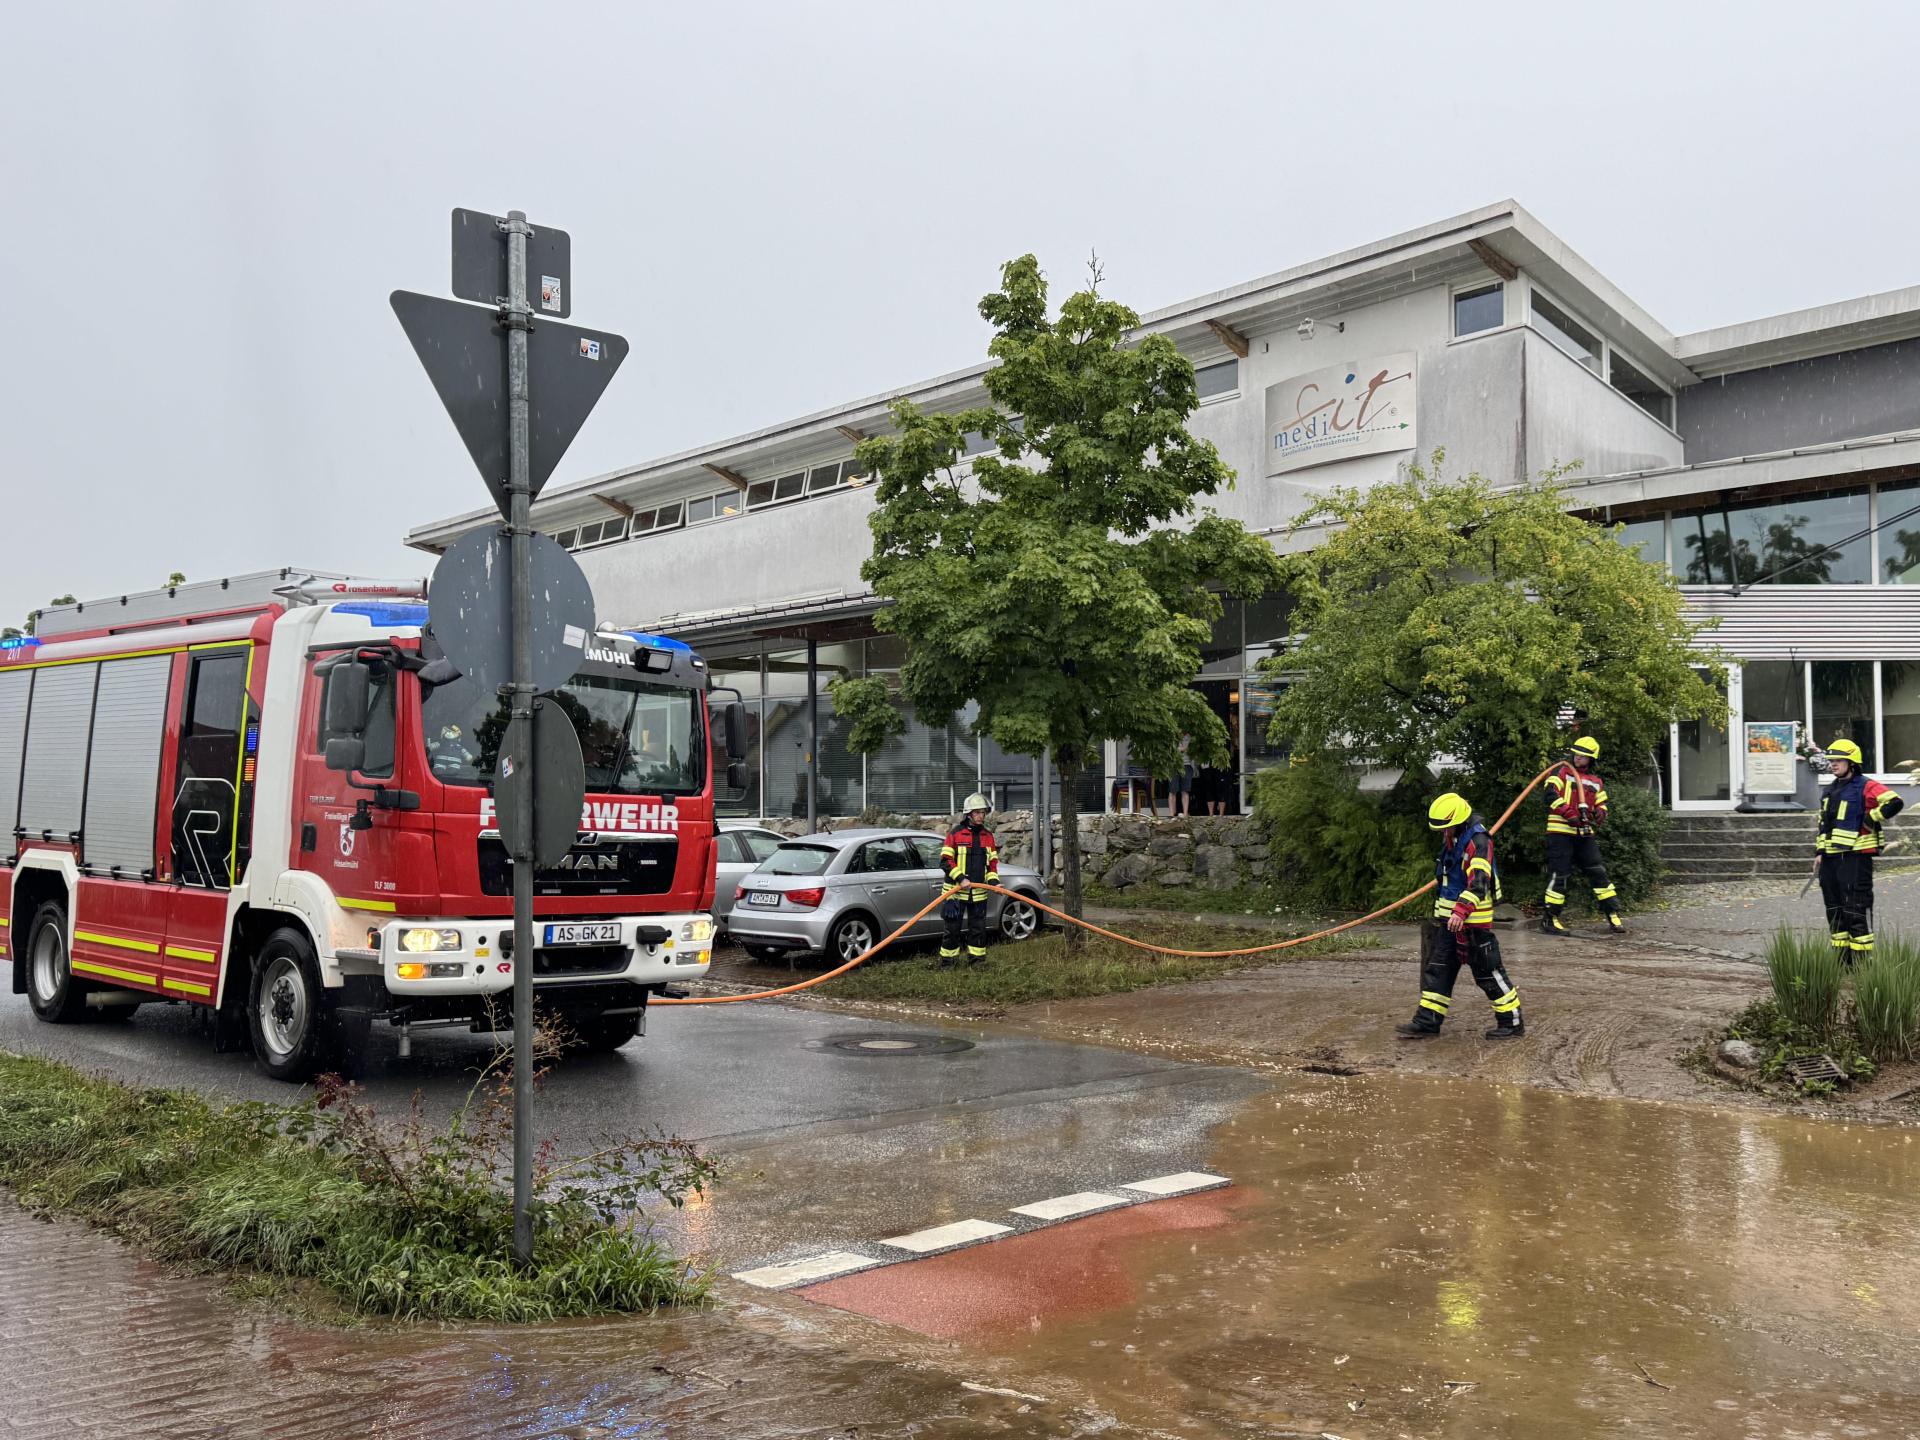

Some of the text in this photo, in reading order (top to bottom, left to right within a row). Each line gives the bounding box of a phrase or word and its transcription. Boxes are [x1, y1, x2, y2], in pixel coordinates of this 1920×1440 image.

[1274, 413, 1328, 450] medi
[348, 584, 397, 593] rosenbauer
[585, 646, 636, 667] MÜHL
[552, 854, 618, 870] MAN
[374, 880, 384, 890] TLF
[558, 926, 616, 941] AS GK 21
